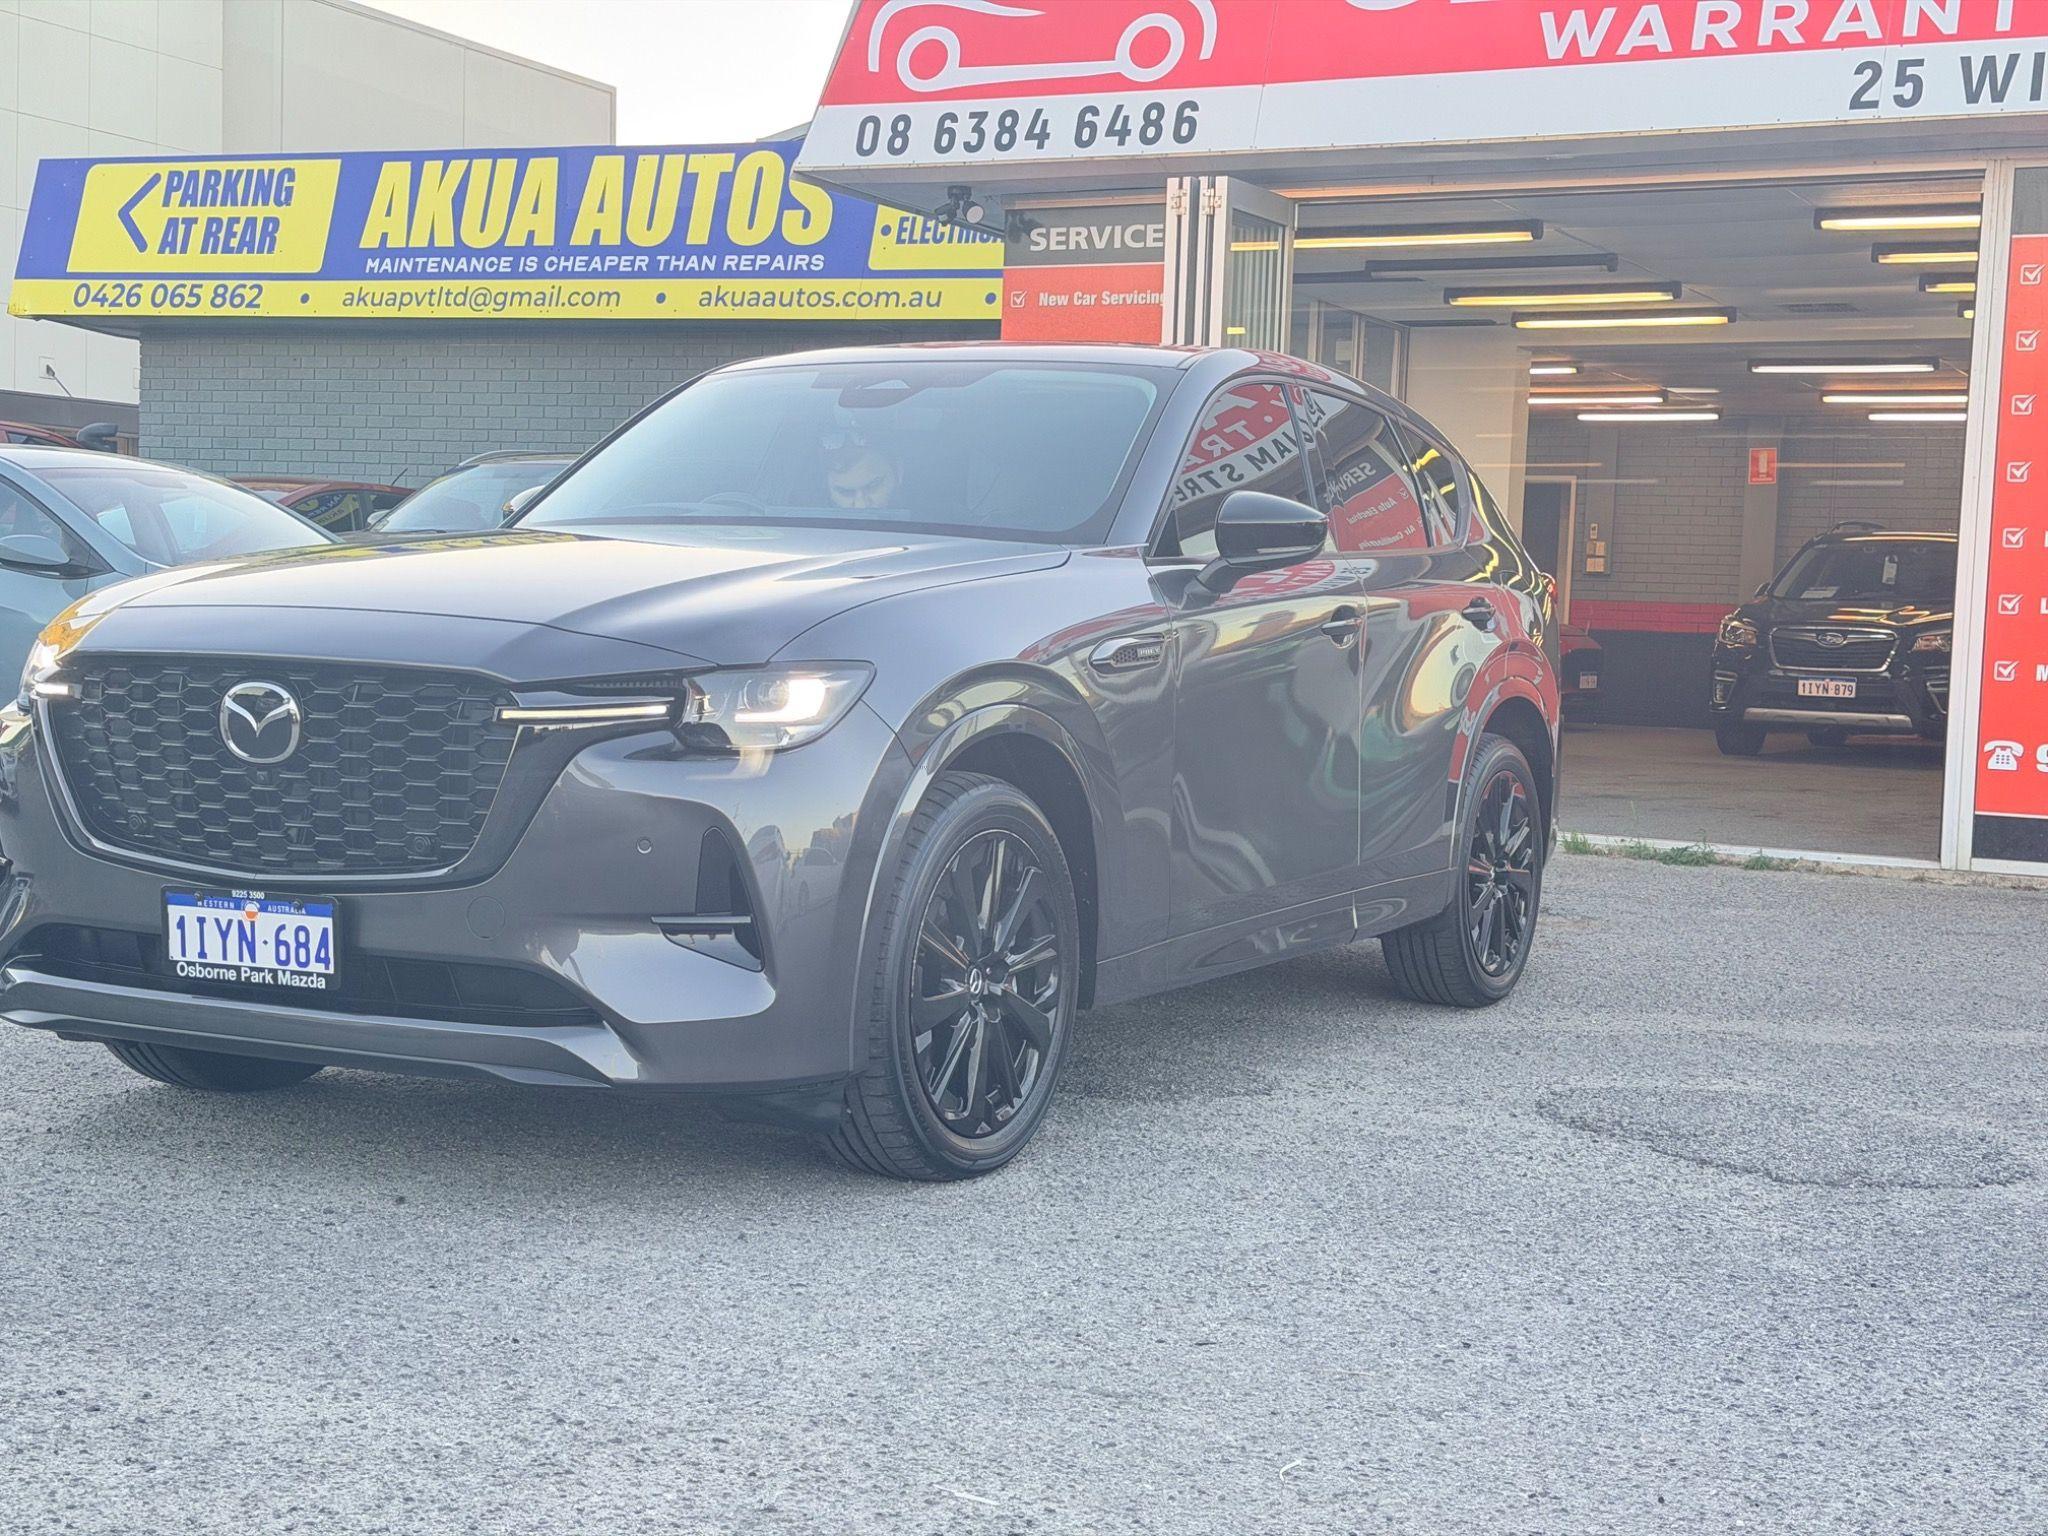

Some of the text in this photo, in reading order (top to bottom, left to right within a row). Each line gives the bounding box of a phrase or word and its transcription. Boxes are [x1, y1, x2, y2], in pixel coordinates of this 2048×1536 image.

[1848, 51, 2047, 111] 25 WI
[855, 100, 1200, 157] 08 6384 6486
[161, 167, 296, 208] PARKING
[358, 150, 834, 249] AKUA AUTOS
[156, 216, 281, 255] AT REAR
[1029, 223, 1165, 252] SERVICE
[365, 254, 826, 273] MAINTENANCE IS CHEAPER THAN REPAIRS
[72, 283, 263, 309] 0426 065 862
[341, 285, 622, 313] akuapvtltd@gmail.com
[697, 285, 943, 310] akuaautos.com.au
[1038, 292, 1070, 307] New
[1073, 291, 1098, 306] Car
[231, 890, 265, 899] 9225 3500
[176, 962, 326, 990] Osborne Park Mazda
